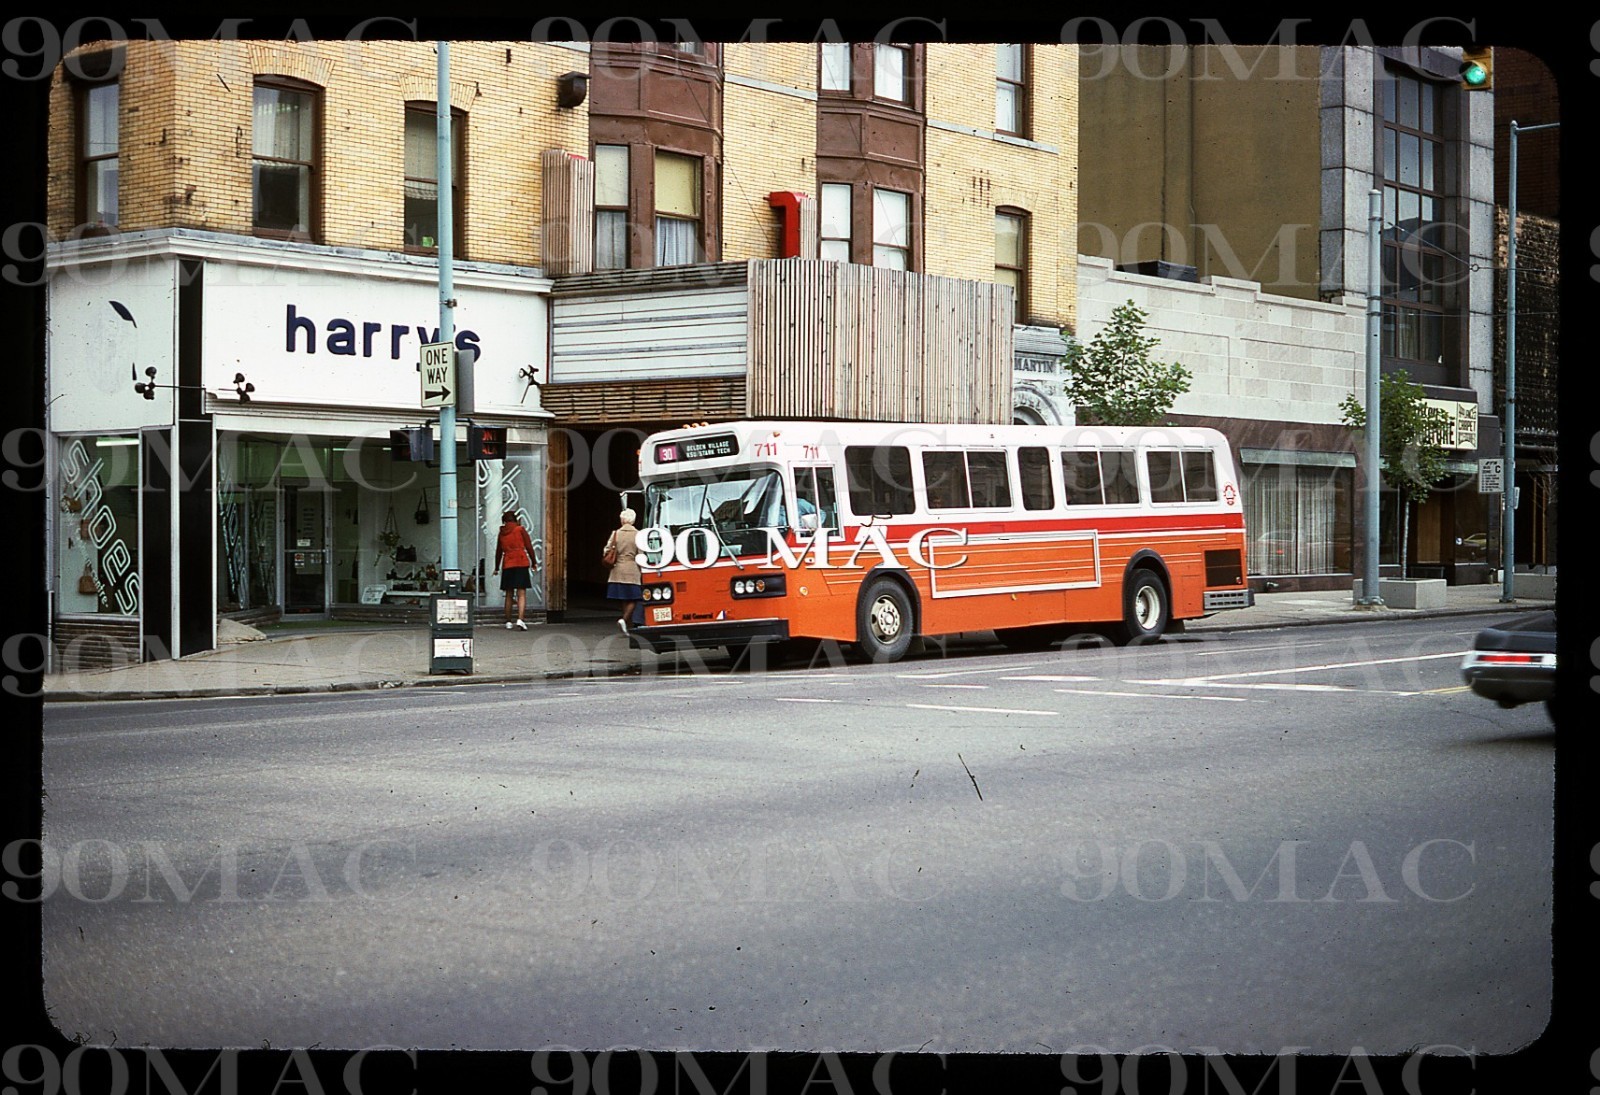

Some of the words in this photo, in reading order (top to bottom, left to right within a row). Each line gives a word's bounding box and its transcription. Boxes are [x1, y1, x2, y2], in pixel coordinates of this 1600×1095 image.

[426, 348, 448, 366] ONE
[1013, 358, 1053, 373] MARTIN
[427, 367, 448, 384] WAY
[708, 441, 729, 449] VILLAGE
[754, 443, 777, 457] 711
[803, 445, 819, 459] 711
[662, 448, 673, 461] 30
[1495, 465, 1501, 474] C
[60, 439, 140, 615] shoes
